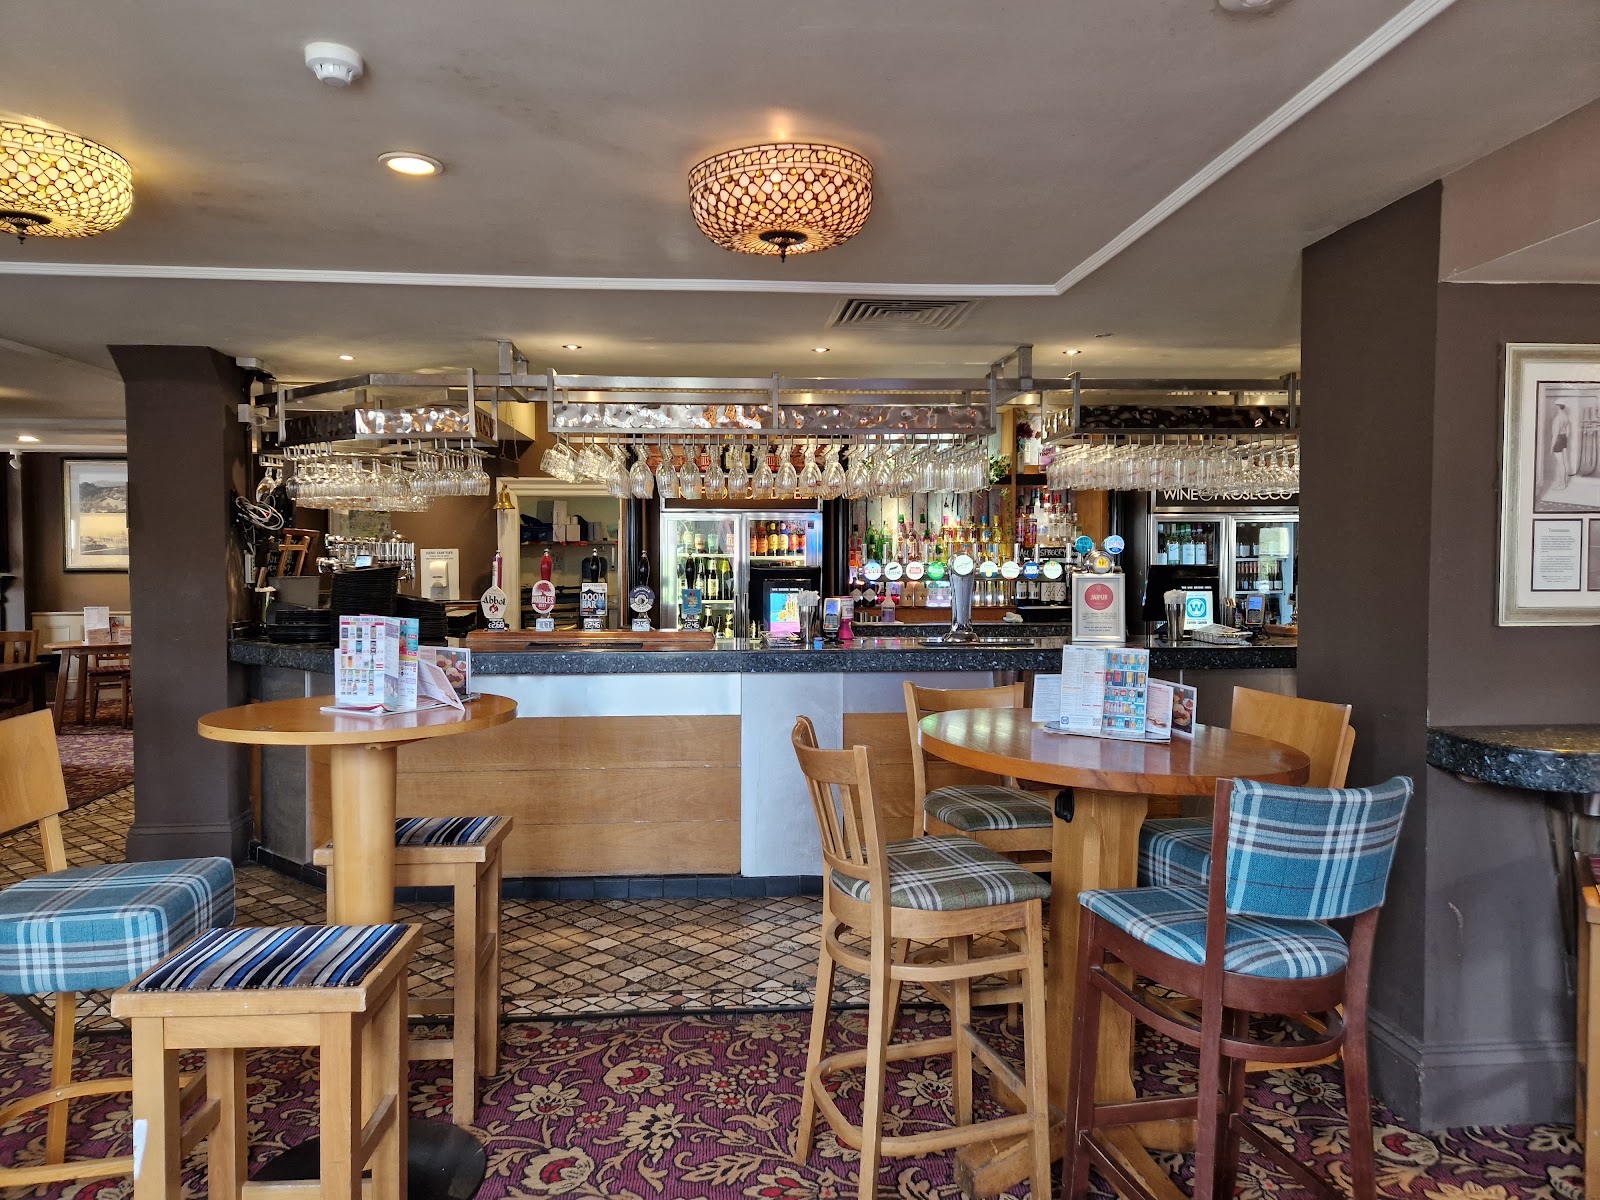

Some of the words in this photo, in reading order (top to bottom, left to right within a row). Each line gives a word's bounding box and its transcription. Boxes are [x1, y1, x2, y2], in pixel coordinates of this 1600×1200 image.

[1163, 489, 1199, 501] WINE
[482, 595, 506, 606] Abbot
[531, 595, 555, 604] RUDDLES
[582, 593, 605, 601] DOOM
[582, 601, 597, 609] BAR
